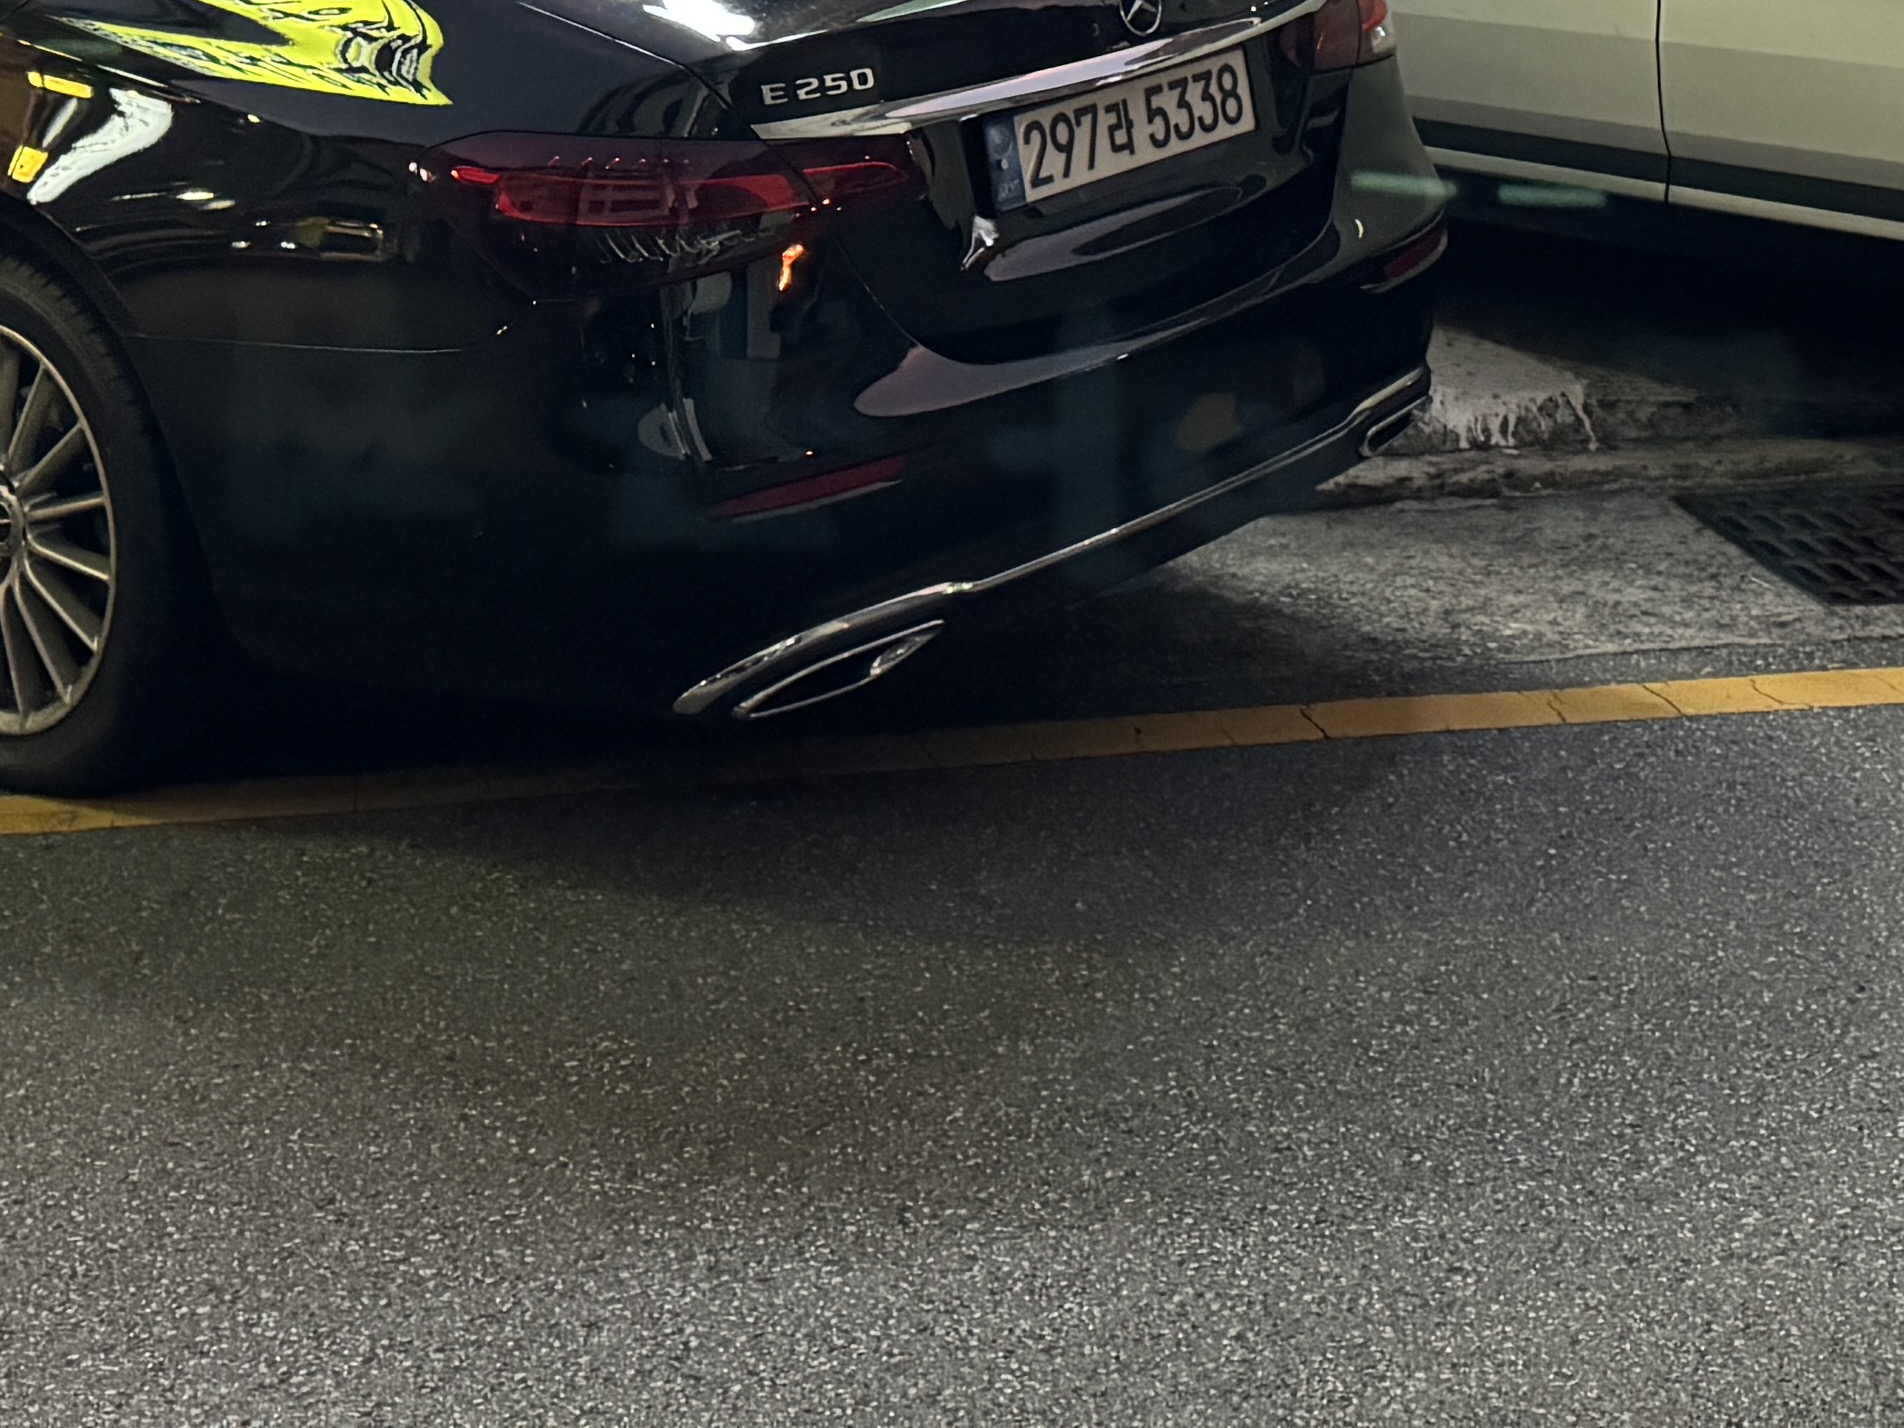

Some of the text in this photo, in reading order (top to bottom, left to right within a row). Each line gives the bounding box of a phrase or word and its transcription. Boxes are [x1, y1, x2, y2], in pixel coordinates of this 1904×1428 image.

[760, 67, 875, 105] E 250
[1022, 62, 1244, 189] 297라 5338
